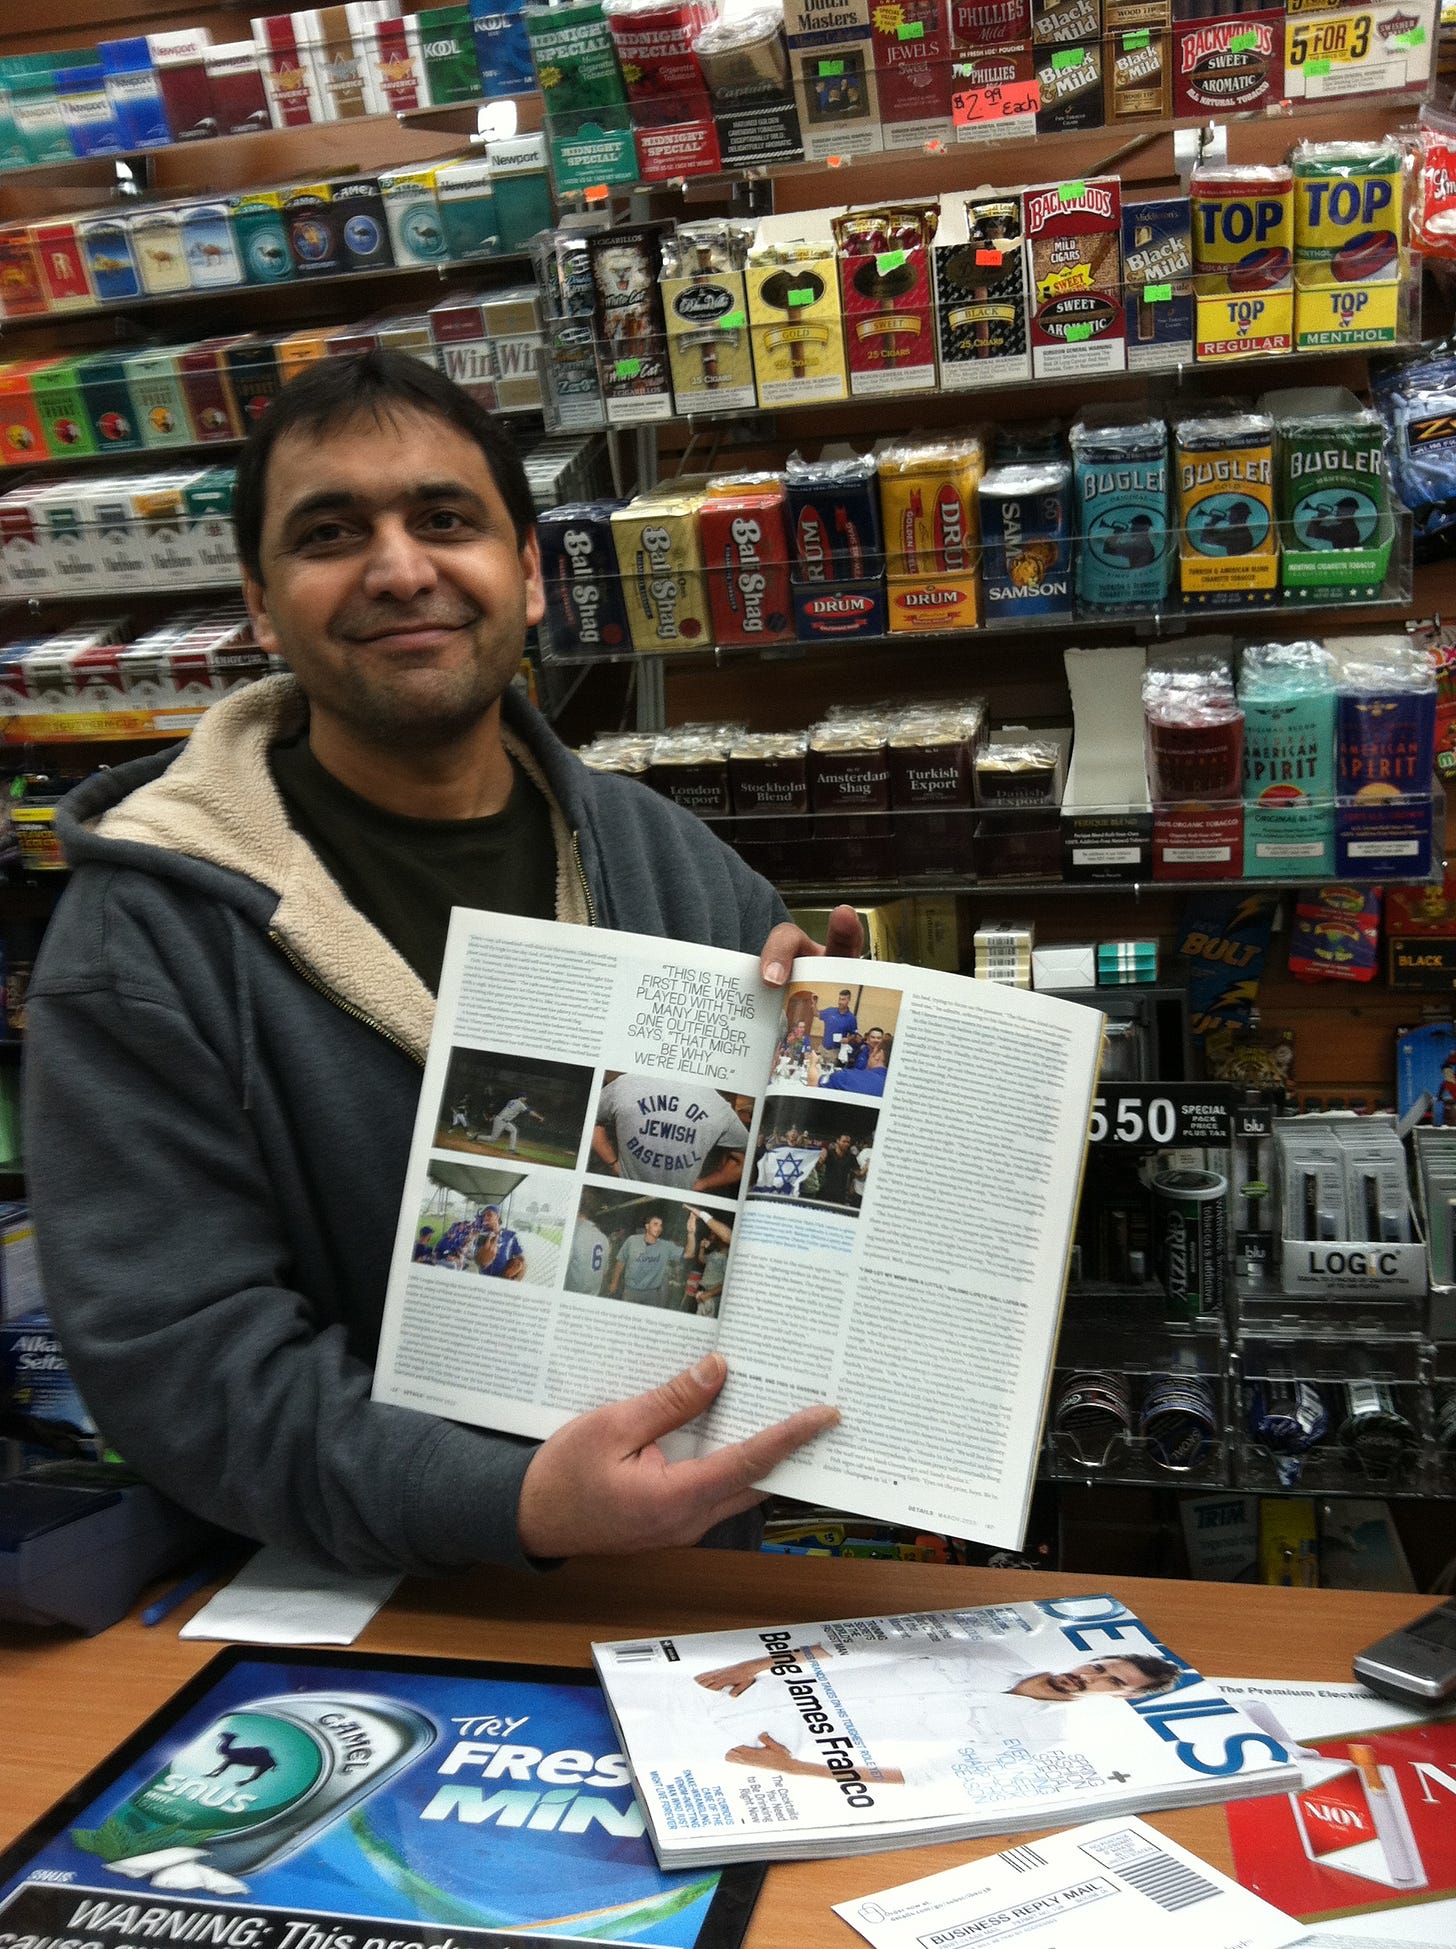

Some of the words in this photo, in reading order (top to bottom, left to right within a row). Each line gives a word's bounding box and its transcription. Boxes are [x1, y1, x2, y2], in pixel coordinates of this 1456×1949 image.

[474, 16, 511, 32] KOOL
[798, 12, 858, 32] Masters
[957, 2, 1025, 28] PHILLIES
[1035, 0, 1095, 35] Black
[529, 21, 610, 48] MIDNIGHT
[613, 25, 692, 46] MIDNIGHT
[1053, 15, 1098, 41] Mild
[423, 40, 460, 57] KOOL
[535, 37, 611, 61] SPECIAL
[1290, 25, 1310, 65] 5
[1313, 24, 1346, 52] FOR
[1351, 15, 1371, 58] 3
[618, 42, 690, 60] SPECIAL
[886, 41, 940, 64] JEWELS
[1116, 46, 1158, 71] Black
[1128, 60, 1161, 80] Mild
[1208, 54, 1248, 70] SWEET
[971, 65, 1016, 85] PHILLIES
[1056, 66, 1099, 97] Mild
[1201, 73, 1257, 92] AROMATIC
[1002, 94, 1039, 116] Each
[641, 131, 707, 147] MIDNIGHT
[492, 151, 539, 167] Newport
[561, 142, 623, 157] MIDNIGHT
[568, 151, 620, 167] SPECIAL
[648, 142, 702, 157] SPECIAL
[1304, 180, 1392, 226] TOP
[1200, 201, 1283, 244] TOP
[1054, 240, 1075, 252] MILD
[1126, 237, 1185, 272] Black
[1051, 250, 1080, 263] CIGARS
[1144, 252, 1189, 281] Mild
[1054, 274, 1084, 290] SWEET
[1056, 299, 1095, 313] SWEET
[1228, 301, 1265, 323] TOP
[1330, 292, 1368, 313] TOP
[964, 308, 999, 318] BLACK
[874, 320, 904, 330] SWEET
[782, 330, 810, 340] GOLD
[1307, 329, 1387, 344] MENTHOL
[1204, 336, 1284, 355] REGULAR
[1291, 448, 1382, 479] BUGLER
[1181, 458, 1272, 491] BUGLER
[641, 526, 672, 580] Bali
[731, 518, 762, 573] Bali
[563, 529, 594, 582] Bali
[905, 591, 958, 606] DRUM
[989, 582, 1067, 600] SAMSON
[650, 578, 678, 639] Shag
[738, 572, 766, 632] Shag
[813, 598, 865, 613] DRUM
[572, 584, 600, 643] Shag
[906, 768, 958, 779] Turkish
[671, 786, 720, 796] London
[741, 782, 806, 793] Stockholm
[839, 782, 872, 795] Shag
[911, 779, 957, 791] Export
[757, 792, 792, 802] Blend
[1180, 932, 1262, 968] BOLT
[1399, 955, 1443, 967] BLACK
[699, 971, 711, 985] IS
[715, 974, 740, 990] THE
[641, 974, 679, 991] FIRST
[681, 981, 711, 998] TIME
[714, 987, 755, 1007] WE'VE
[636, 987, 687, 1005] PLAYED
[690, 997, 723, 1013] WITH
[726, 1003, 755, 1020] THIS
[652, 1002, 692, 1020] MANY
[636, 1012, 664, 1028] ONE
[666, 1018, 747, 1043] OUTFIELDER
[661, 1043, 678, 1057] BE
[682, 1046, 713, 1063] WHY
[709, 1039, 751, 1058] MIGHT
[634, 1052, 676, 1070] WE'RE
[637, 1094, 680, 1115] KING
[684, 1103, 709, 1123] OF
[1181, 1105, 1227, 1116] SPECIAL
[639, 1119, 697, 1145] JEWISH
[1243, 1118, 1264, 1132] blu
[626, 1136, 702, 1171] BASEBALL
[591, 1244, 603, 1272] 6
[1166, 1209, 1188, 1302] GRIZZLY
[1245, 1244, 1266, 1259] blu
[1309, 1251, 1398, 1275] LOGIC
[821, 1681, 838, 1700] TAKES
[1218, 1685, 1244, 1695] The
[1248, 1686, 1315, 1699] Premium
[832, 1699, 842, 1709] ON
[758, 1631, 803, 1676] Being
[783, 1678, 835, 1735] James
[815, 1736, 875, 1808] Franco
[836, 1708, 850, 1720] HIS
[451, 1715, 530, 1738] TRY
[842, 1719, 867, 1748] TOUGHEST
[317, 1713, 372, 1776] CAMEL
[859, 1748, 876, 1767] ROLE
[650, 1770, 664, 1787] MIGHT
[772, 1775, 784, 1788] The
[656, 1787, 669, 1800] LIVE
[666, 1784, 678, 1797] MAN
[712, 1786, 724, 1797] THE
[750, 1784, 762, 1793] Be
[671, 1798, 683, 1812] WHO
[701, 1787, 715, 1804] CASE
[708, 1803, 718, 1812] OF
[713, 1814, 724, 1827] THE
[717, 1797, 735, 1826] CURIOUS
[754, 1794, 773, 1823] Drinking
[772, 1803, 789, 1822] Need
[777, 1788, 800, 1821] Cocktails
[662, 1800, 679, 1830] FOREVER
[676, 1813, 690, 1829] JUST
[749, 1807, 761, 1824] Now
[1303, 1801, 1364, 1831] NJOY
[930, 1914, 1011, 1946] BUSINESS
[1011, 1896, 1062, 1918] REPLY
[1062, 1882, 1102, 1900] MAIL
[66, 1899, 276, 1947] WARNING:
[276, 1920, 357, 1949] This
